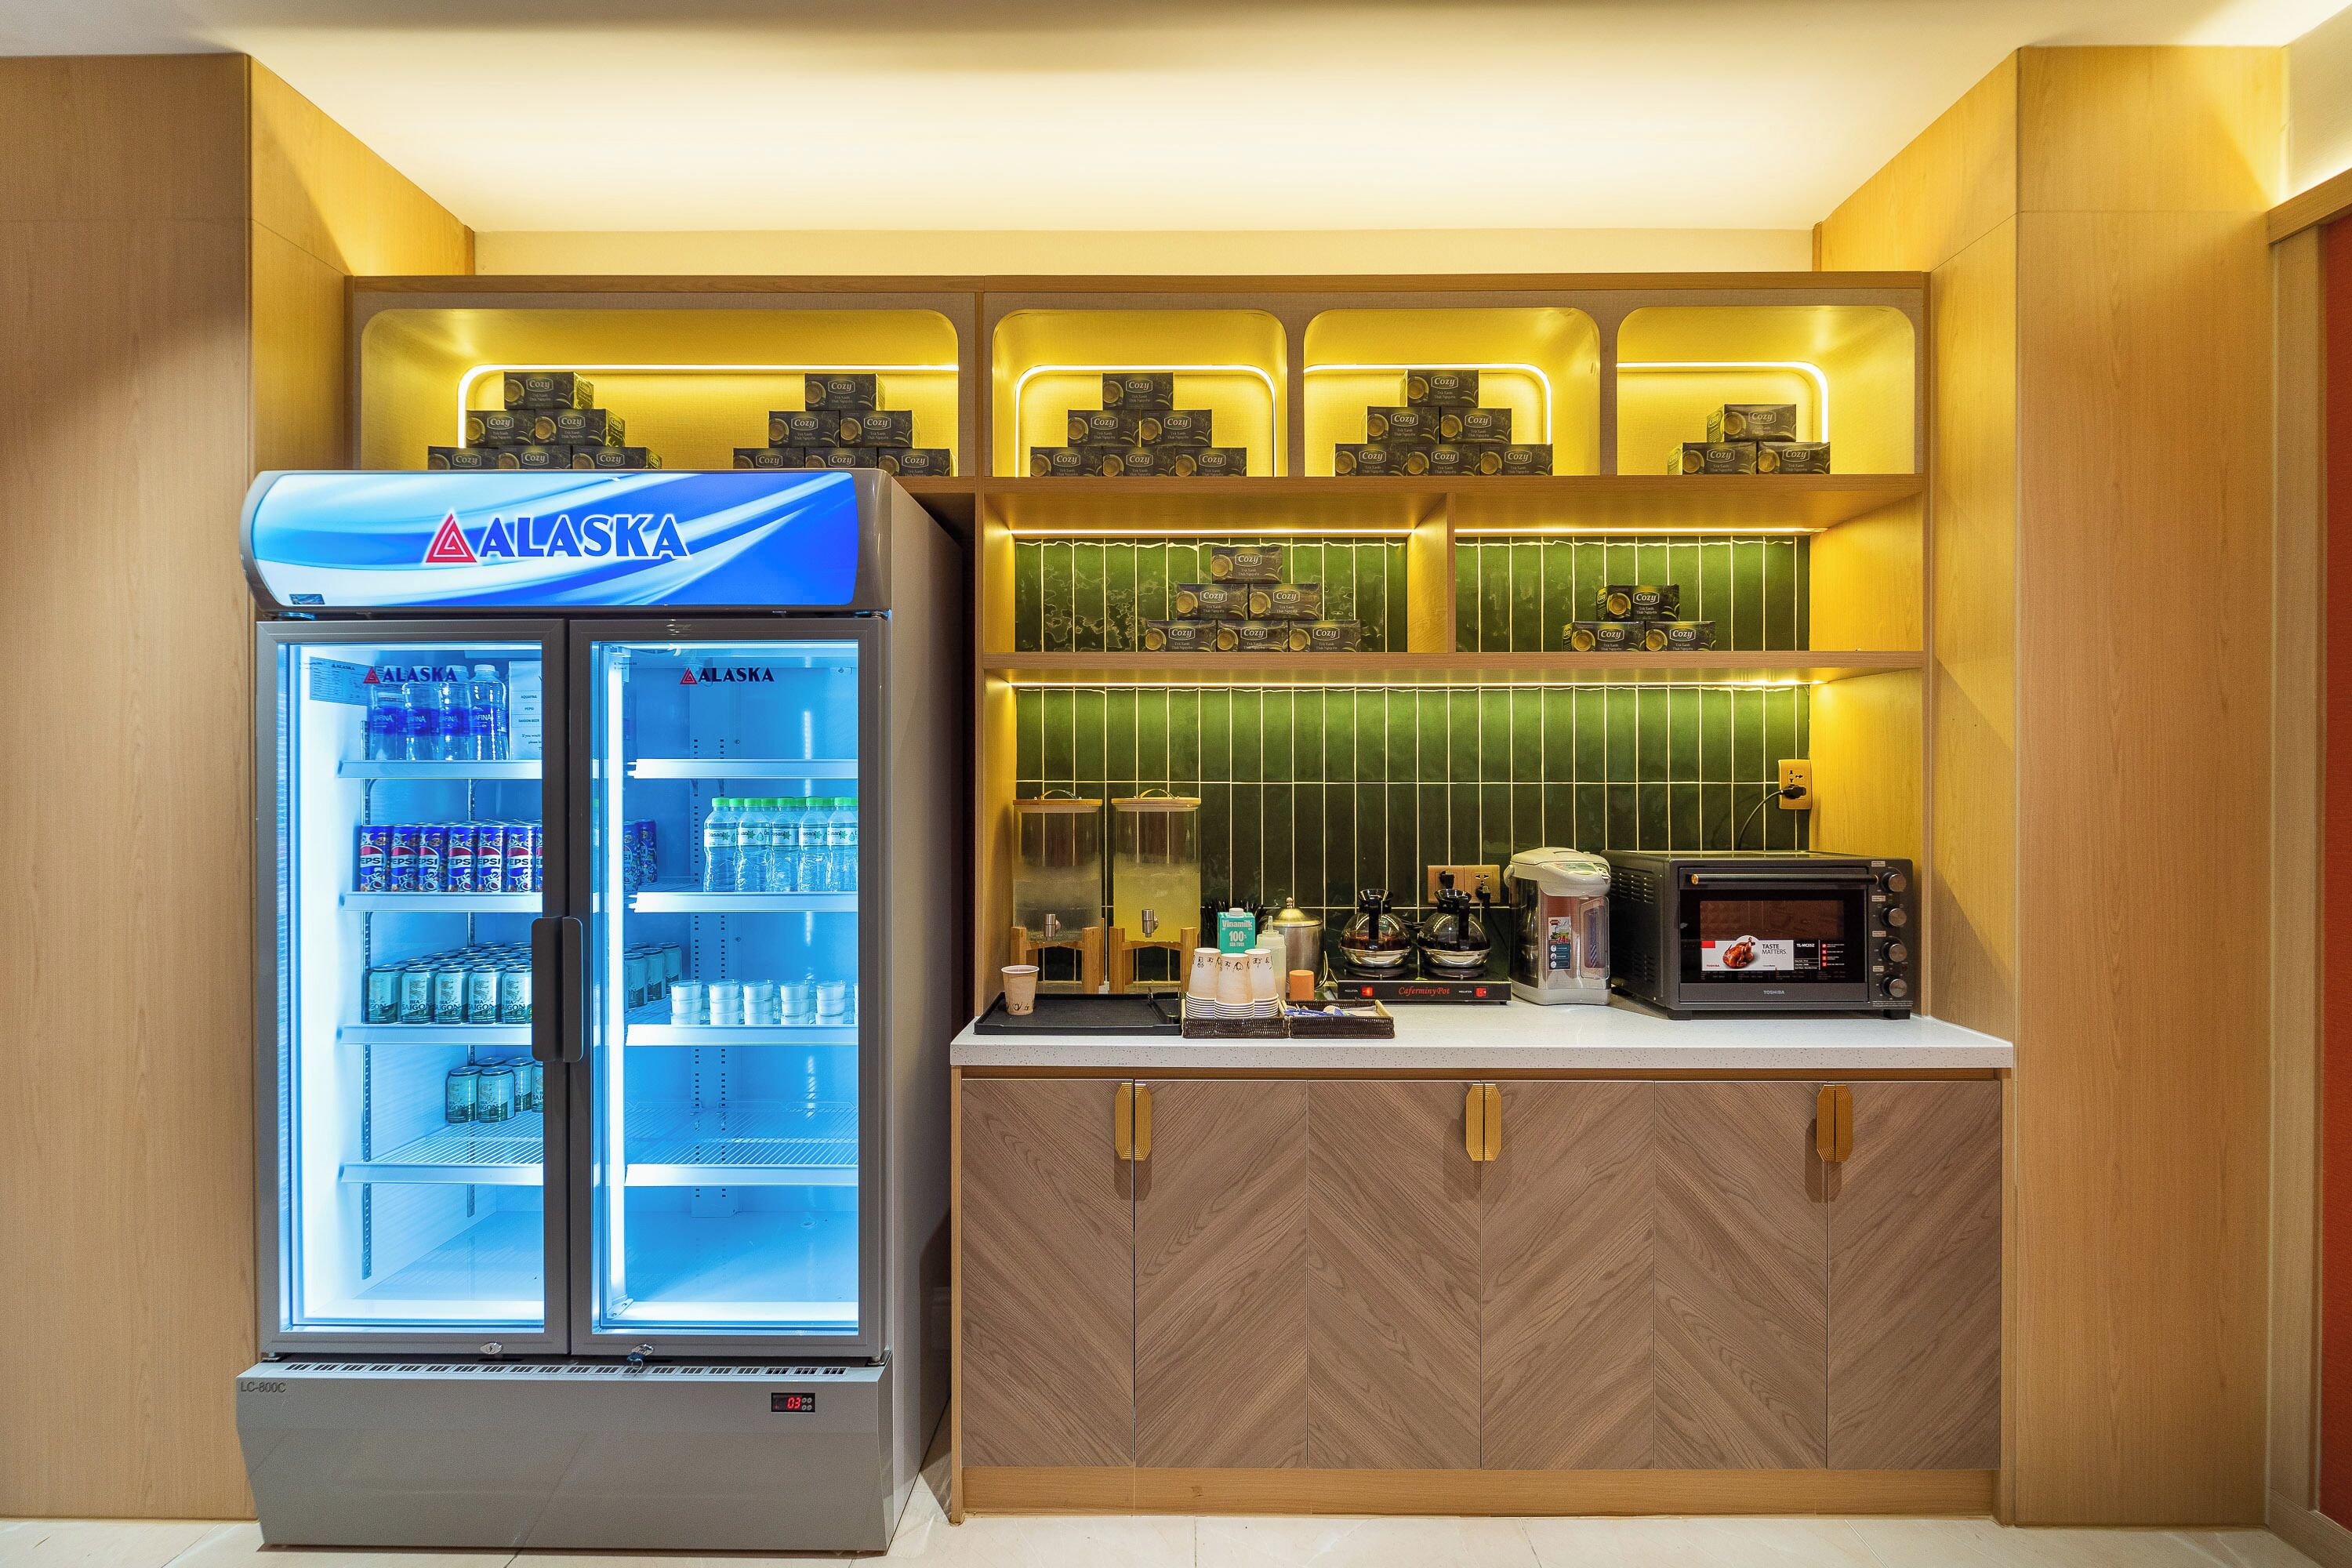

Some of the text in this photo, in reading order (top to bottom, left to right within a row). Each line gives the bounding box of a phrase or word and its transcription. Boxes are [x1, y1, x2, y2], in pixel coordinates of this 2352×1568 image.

[529, 380, 550, 390] Cozy
[831, 382, 852, 392] Cozy
[1129, 381, 1149, 390] Cozy
[1434, 377, 1455, 387] Cozy
[561, 417, 582, 427] Cozy
[1394, 415, 1415, 424] Cozy
[1468, 416, 1488, 426] Cozy
[1751, 412, 1773, 422] Cozy
[490, 418, 510, 427] Cozy
[794, 419, 815, 429] Cozy
[867, 418, 887, 428] Cozy
[1094, 418, 1115, 428] Cozy
[1167, 418, 1188, 427] Cozy
[524, 454, 546, 463] Cozy
[600, 455, 621, 464] Cozy
[1362, 452, 1383, 462] Cozy
[1435, 452, 1455, 462] Cozy
[1508, 452, 1529, 462] Cozy
[1710, 451, 1731, 460] Cozy
[1786, 450, 1806, 459] Cozy
[456, 456, 477, 466] Cozy
[759, 456, 779, 466] Cozy
[831, 456, 852, 466] Cozy
[905, 456, 925, 466] Cozy
[1057, 456, 1077, 465] Cozy
[1129, 456, 1150, 465] Cozy
[1202, 456, 1223, 465] Cozy
[479, 517, 689, 557] ALASKA
[1238, 555, 1258, 564] Cozy
[1203, 592, 1224, 601] Cozy
[1276, 592, 1297, 601] Cozy
[1636, 593, 1656, 603] Cozy
[1171, 629, 1192, 638] Cozy
[1243, 629, 1264, 638] Cozy
[1316, 629, 1337, 638] Cozy
[1601, 630, 1621, 640] Cozy
[1672, 630, 1693, 639] Cozy
[383, 667, 458, 682] ALASKA
[698, 667, 775, 682] ALASKA
[241, 1381, 287, 1393] LC-800C
[787, 1397, 801, 1409] 03
